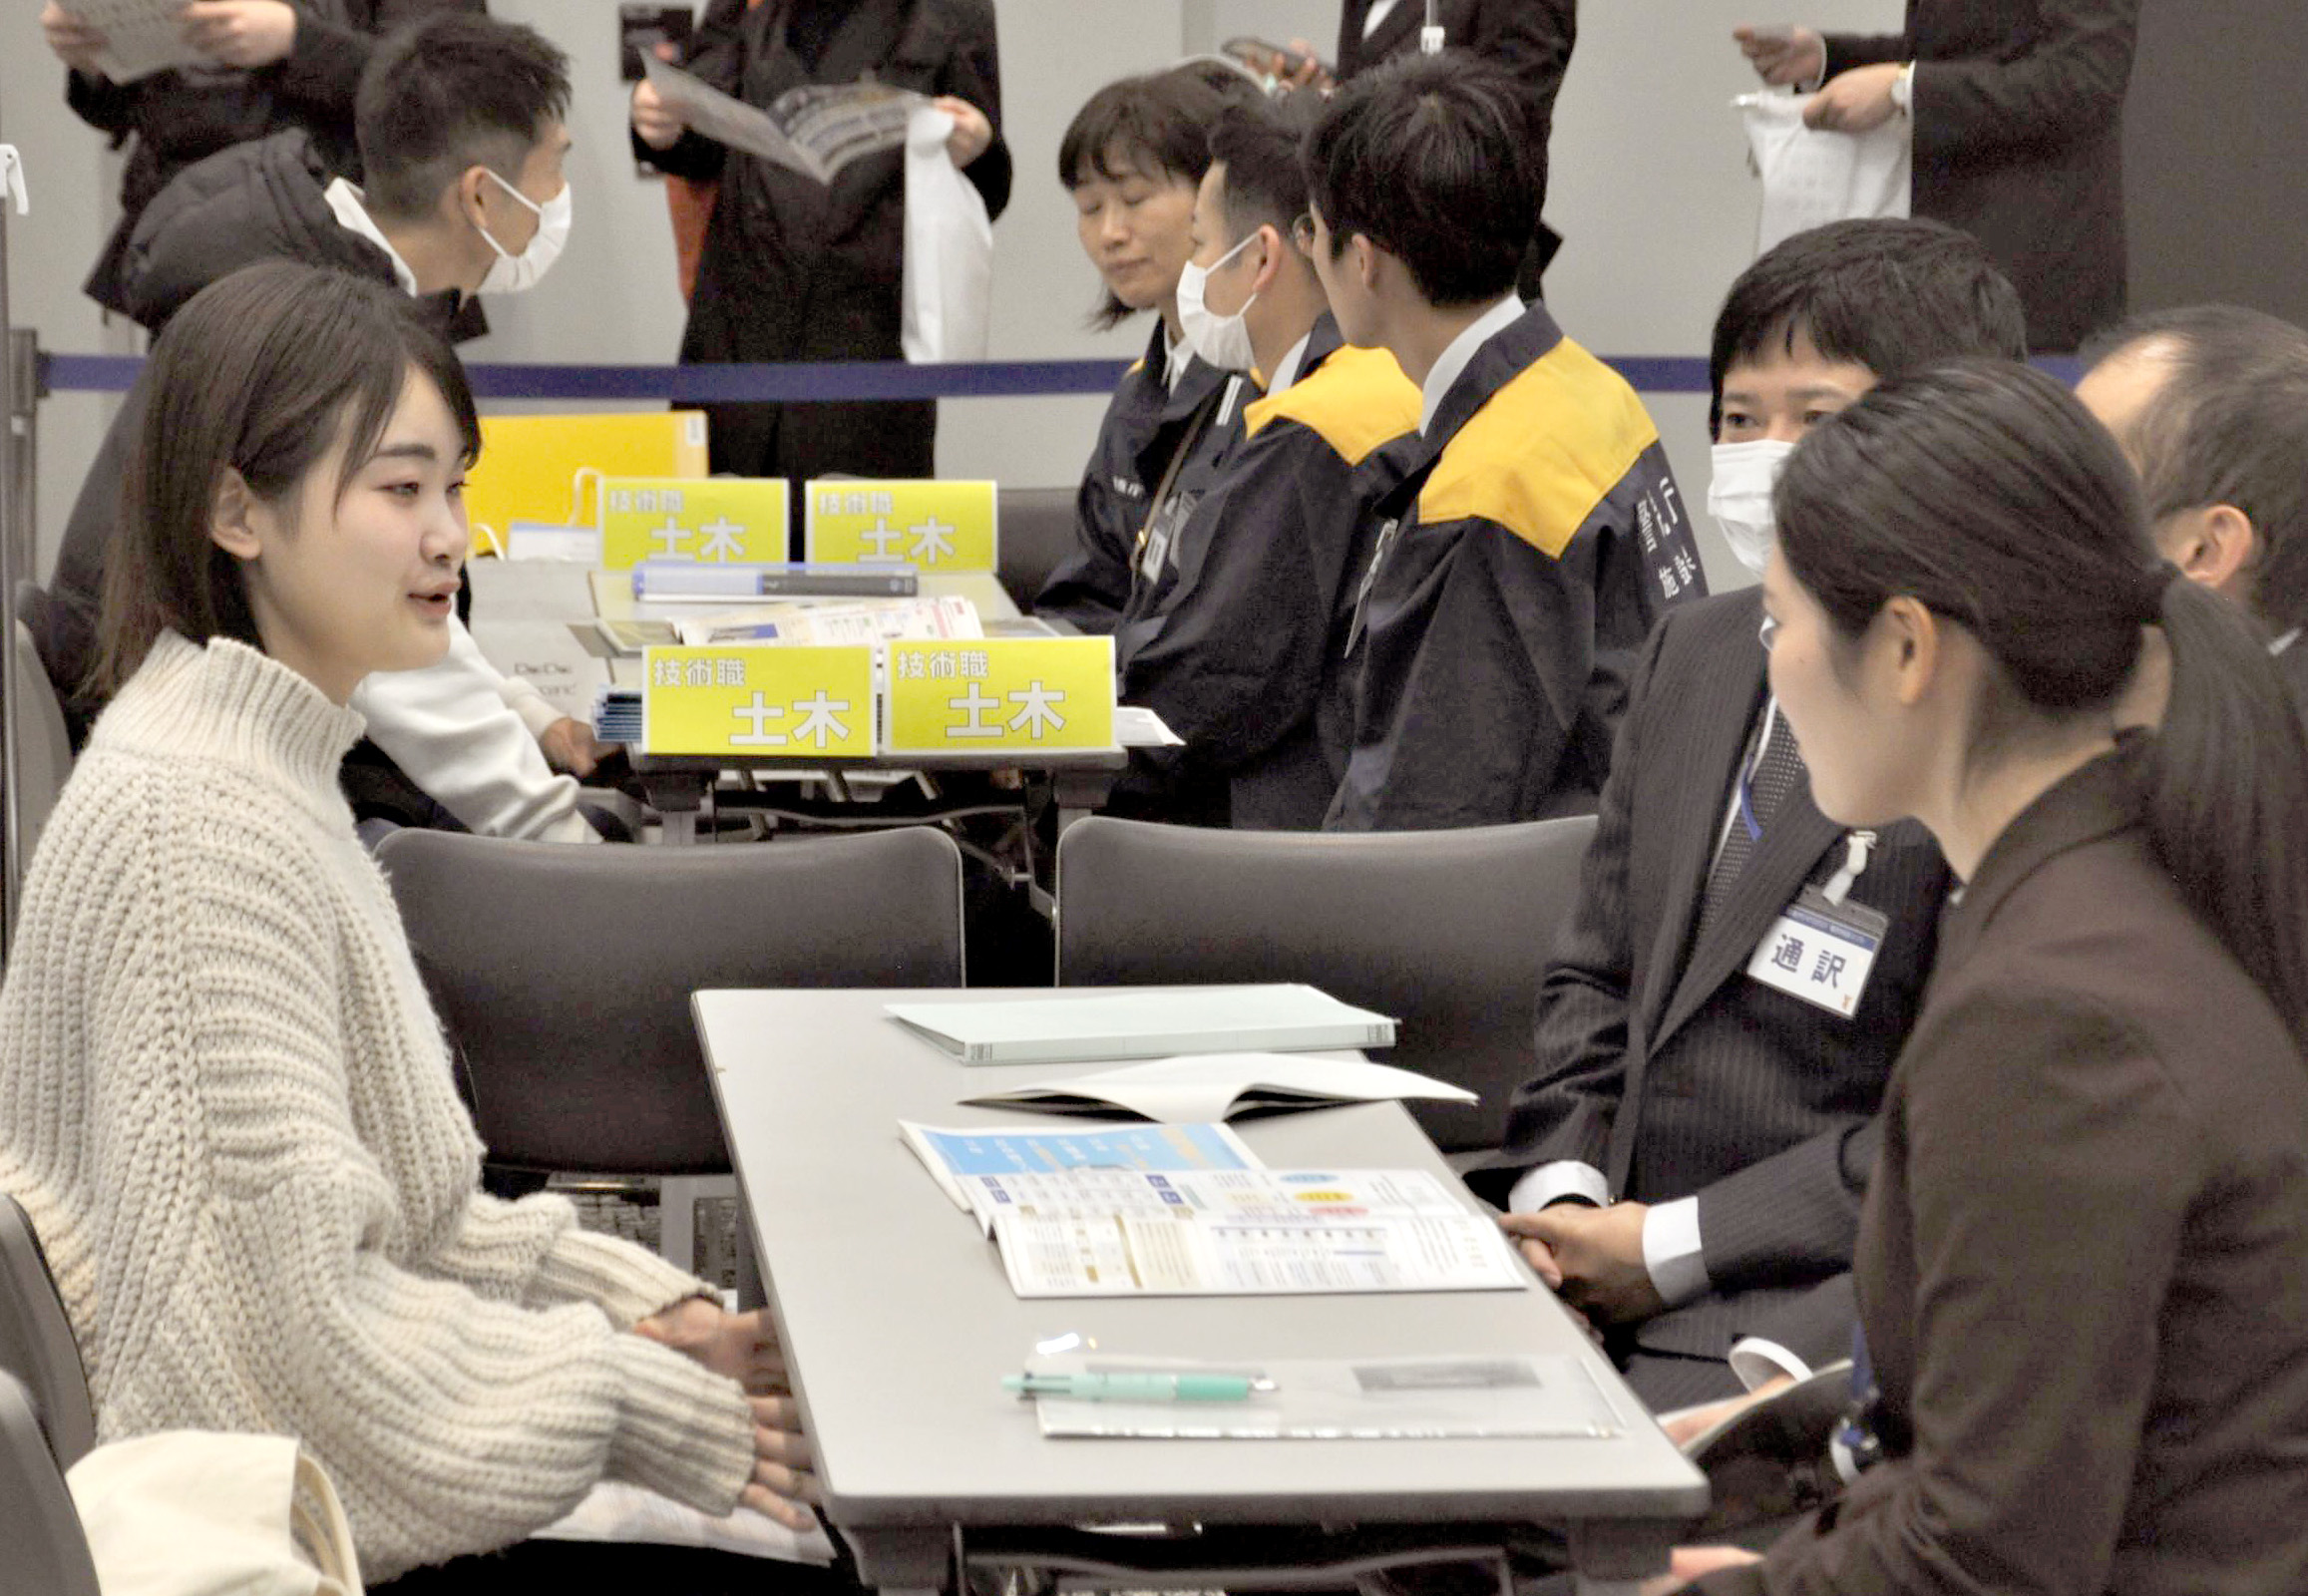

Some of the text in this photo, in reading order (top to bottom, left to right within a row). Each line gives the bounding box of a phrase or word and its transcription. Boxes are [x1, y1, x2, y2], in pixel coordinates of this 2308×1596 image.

[648, 515, 746, 564] 土木
[857, 516, 956, 565] 土木
[653, 657, 746, 687] 技術職
[897, 649, 989, 679] 技術職
[729, 690, 852, 749] 土木
[945, 680, 1067, 739] 土木
[1770, 934, 1847, 989] 通訳
